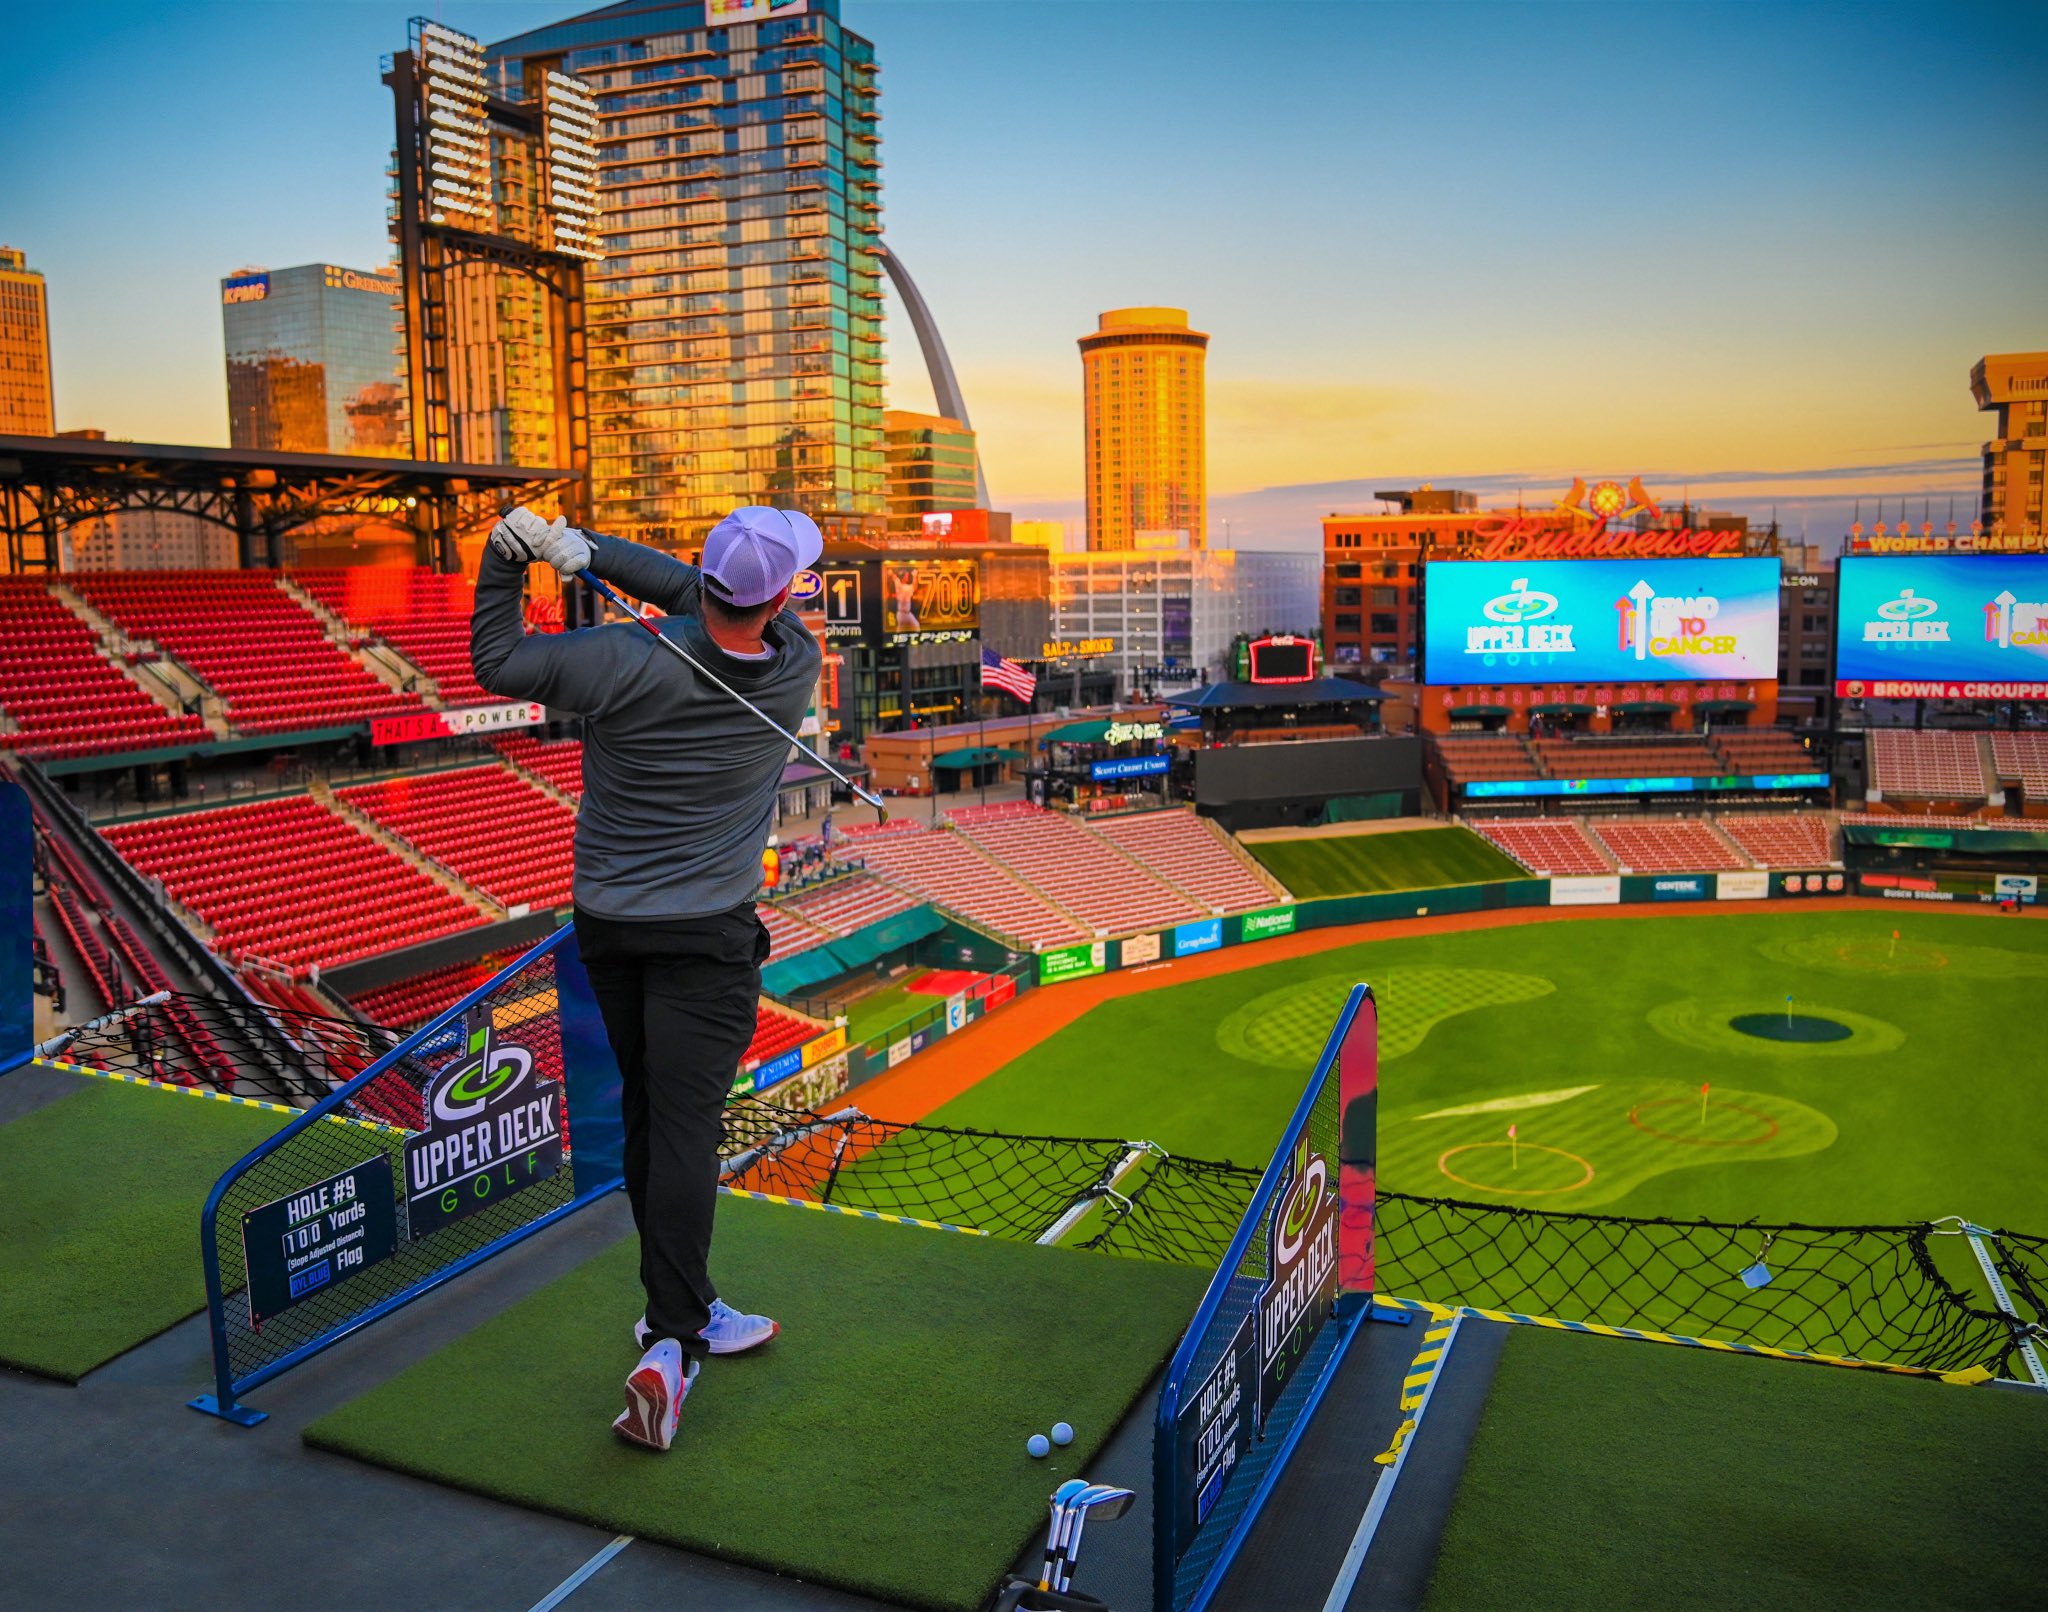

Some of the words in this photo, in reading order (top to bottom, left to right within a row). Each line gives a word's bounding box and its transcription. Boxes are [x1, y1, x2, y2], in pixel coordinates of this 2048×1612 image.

[224, 283, 265, 304] KPMG
[1474, 517, 1741, 561] Budweiser
[1869, 536, 1949, 552] WORLD
[918, 572, 972, 619] 700
[826, 624, 862, 638] phorm
[920, 630, 972, 642] PHORM
[1467, 626, 1524, 649] UPPER
[1528, 625, 1573, 649] DECK
[1680, 617, 1706, 636] TO
[1042, 641, 1071, 657] SALT
[1079, 638, 1114, 654] SMOKE
[1483, 653, 1556, 667] GOLF
[1649, 636, 1736, 656] CANCER
[1873, 683, 1944, 698] BROWN
[1948, 686, 1960, 697] &
[377, 719, 424, 741] THAT'S
[430, 717, 437, 733] A
[465, 708, 526, 726] POWER
[1883, 888, 1912, 899] BUSCH
[1914, 890, 1954, 900] STADIUM
[1256, 910, 1294, 929] National
[412, 1121, 493, 1190] UPPER
[498, 1094, 555, 1154] DECK
[441, 1152, 537, 1213] GOLF
[287, 1187, 329, 1225] HOLE
[333, 1175, 356, 1205] #9
[287, 1223, 321, 1254] 100
[329, 1201, 366, 1231] Yards
[288, 1254, 308, 1272] (Slope
[310, 1241, 336, 1259] Adjusted
[336, 1225, 364, 1245] Distance)
[291, 1274, 306, 1293] RYL
[309, 1263, 329, 1284] BLUE
[337, 1246, 363, 1271] Flag
[1265, 1258, 1305, 1358] UPPER
[1307, 1212, 1334, 1295] DECK
[1276, 1287, 1324, 1381] GOLF
[1200, 1369, 1223, 1426] HOLE
[1224, 1349, 1236, 1392] #9
[1202, 1419, 1221, 1462] 100
[1220, 1382, 1240, 1425] Yards
[1222, 1440, 1236, 1476] Flag
